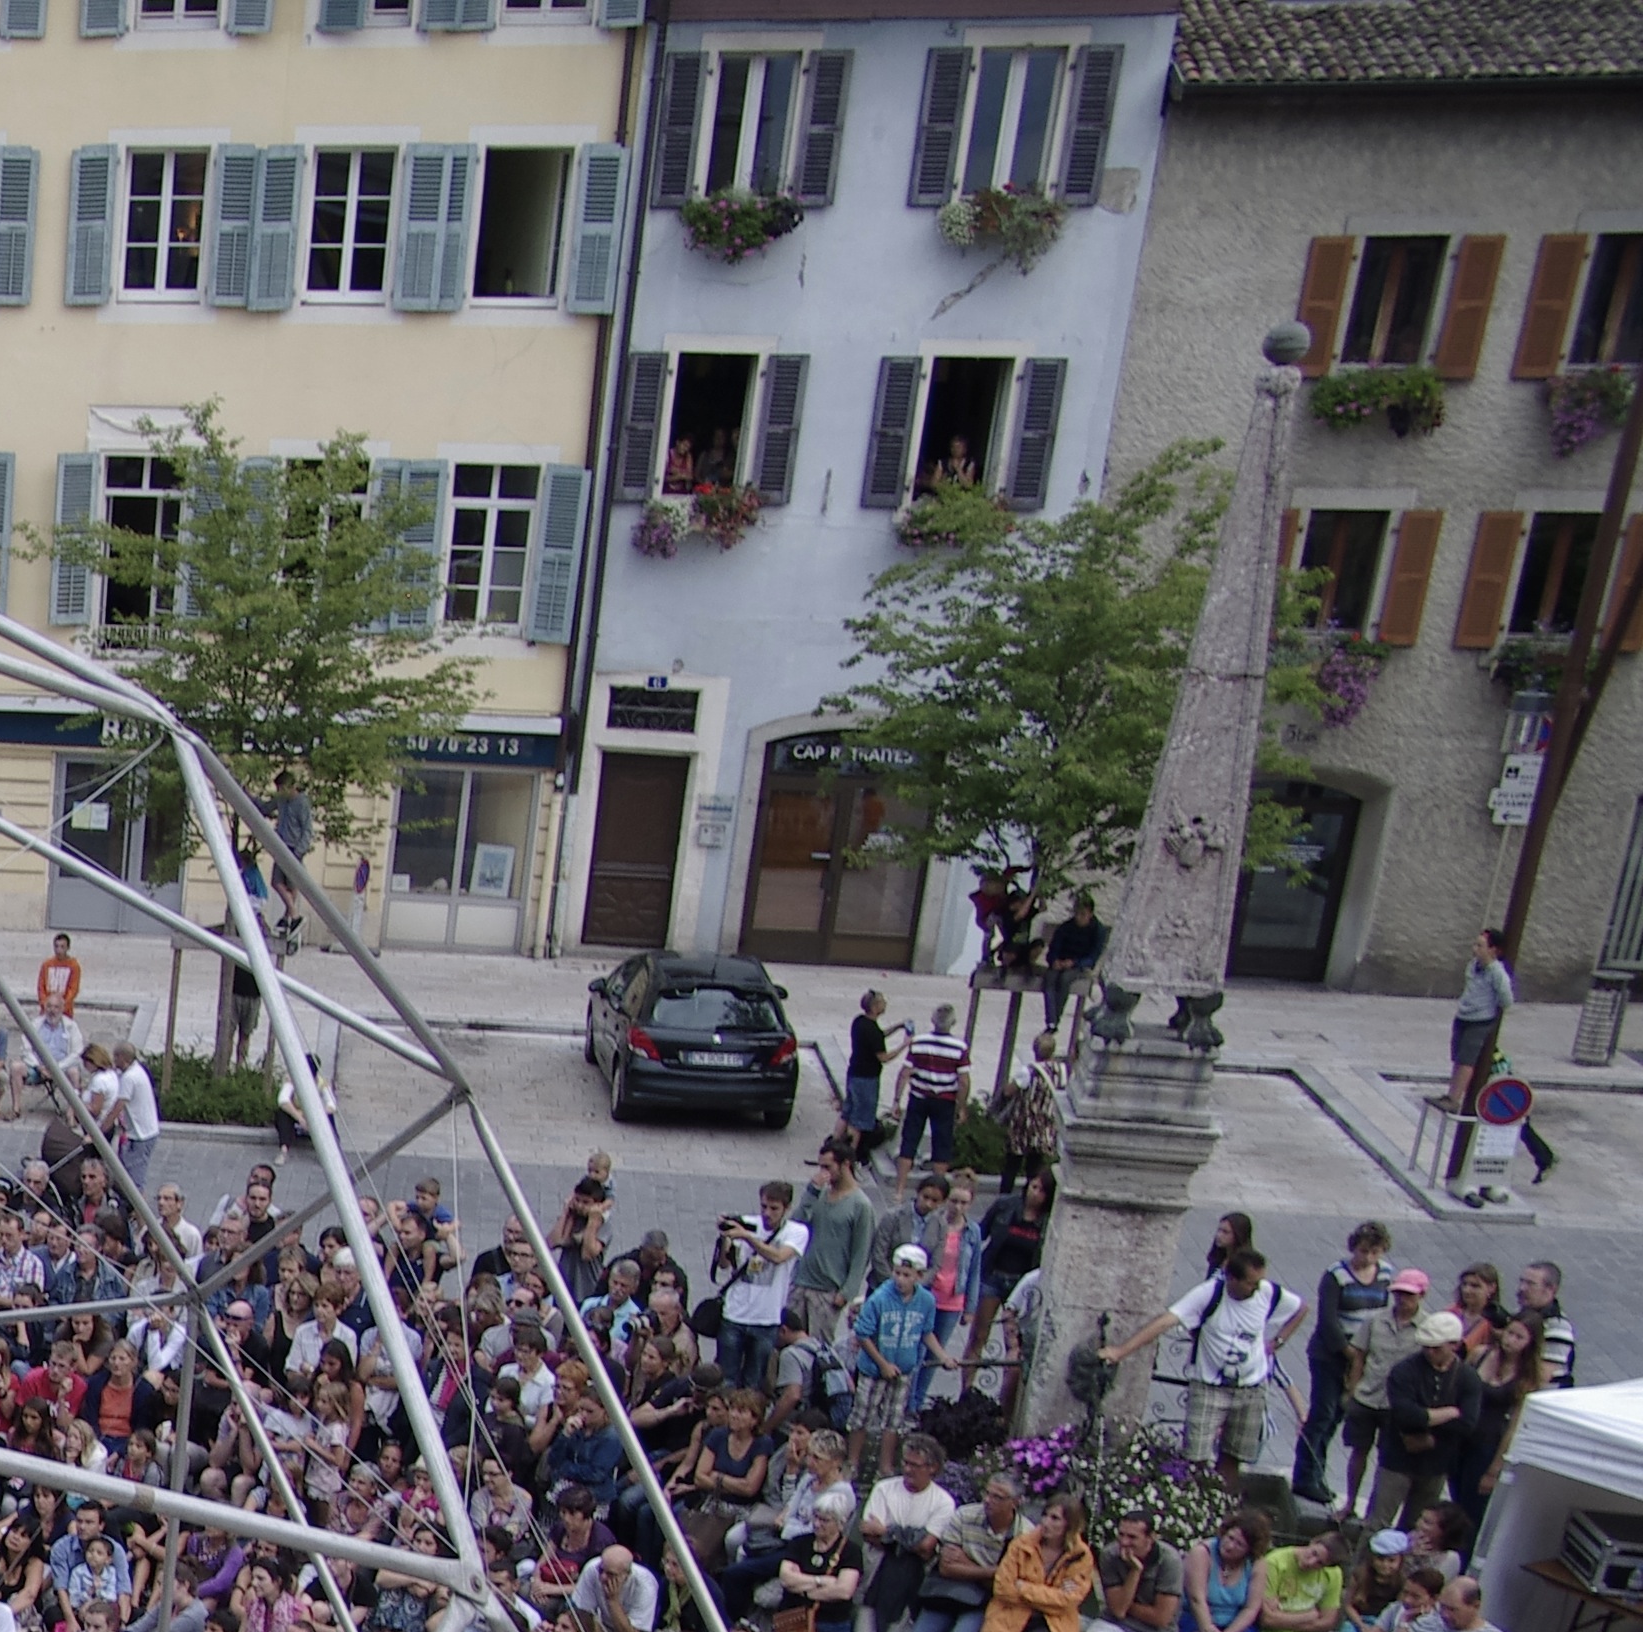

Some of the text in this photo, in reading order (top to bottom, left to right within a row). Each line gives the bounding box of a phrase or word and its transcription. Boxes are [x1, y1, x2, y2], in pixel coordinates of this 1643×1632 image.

[406, 735, 429, 752] 50
[437, 736, 459, 753] 70
[466, 737, 489, 755] 23
[497, 738, 520, 756] 13
[793, 744, 914, 765] CAP RTRAITES
